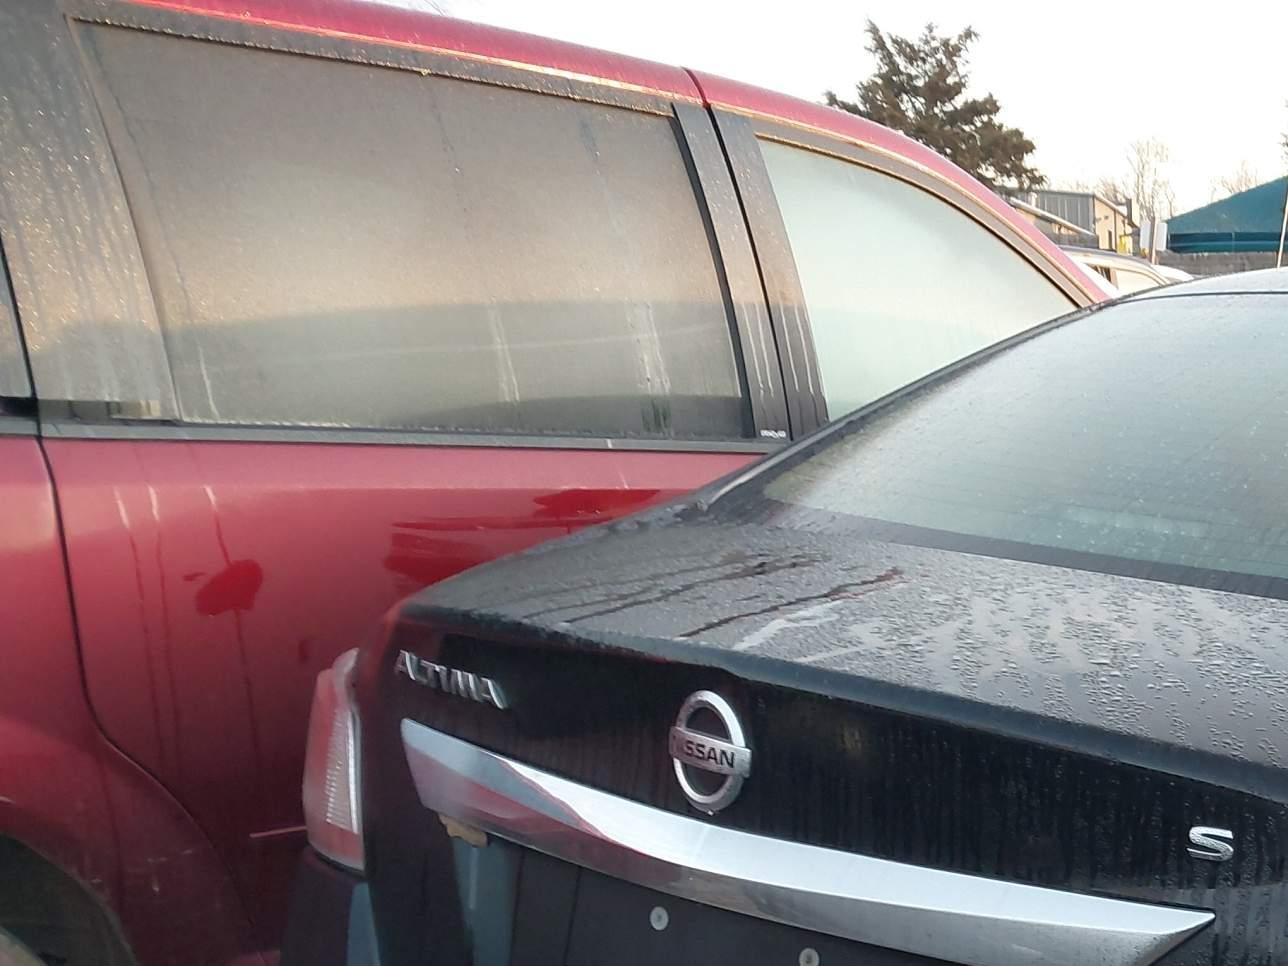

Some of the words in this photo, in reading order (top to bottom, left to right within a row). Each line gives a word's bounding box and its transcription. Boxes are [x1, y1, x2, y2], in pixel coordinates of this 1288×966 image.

[395, 650, 507, 709] ALTIMA
[675, 736, 735, 769] SSAN
[1187, 826, 1234, 861] S
